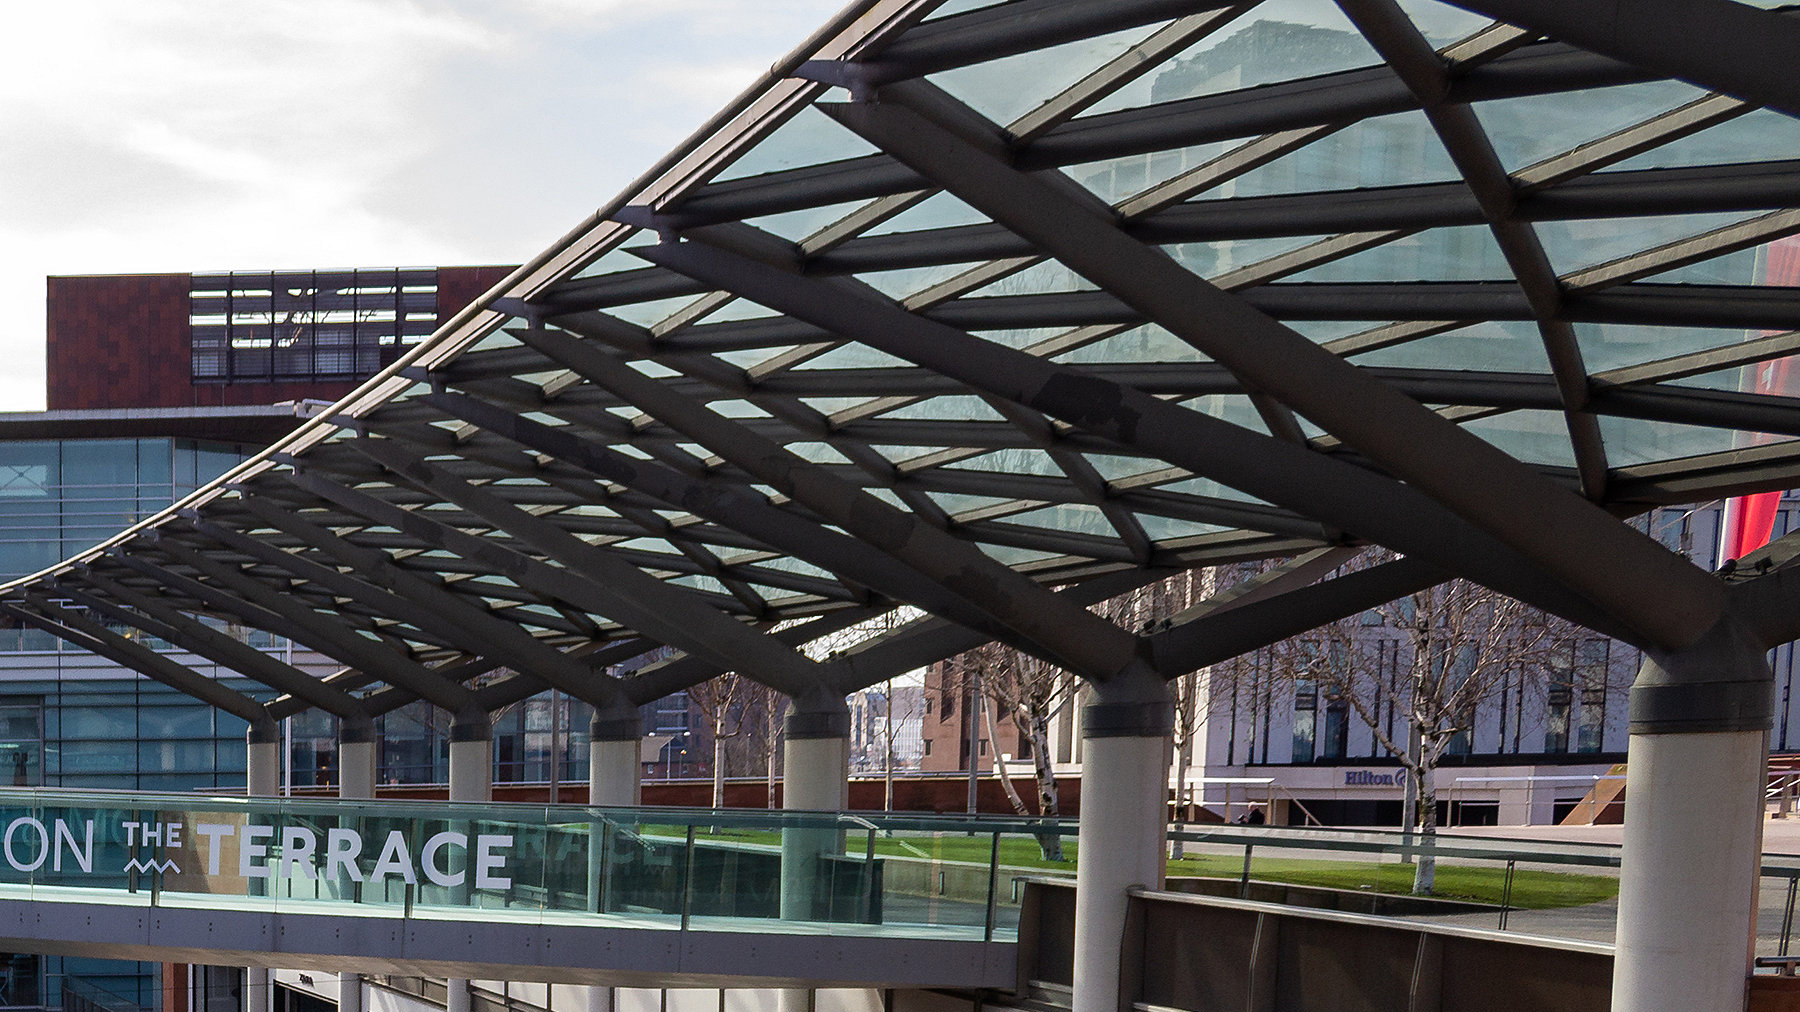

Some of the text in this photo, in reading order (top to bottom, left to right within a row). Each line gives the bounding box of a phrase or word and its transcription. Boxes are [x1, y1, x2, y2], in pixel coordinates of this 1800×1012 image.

[1344, 770, 1393, 786] Hilton
[4, 817, 93, 874] ON
[122, 821, 182, 849] THE
[197, 823, 514, 890] TERRACE
